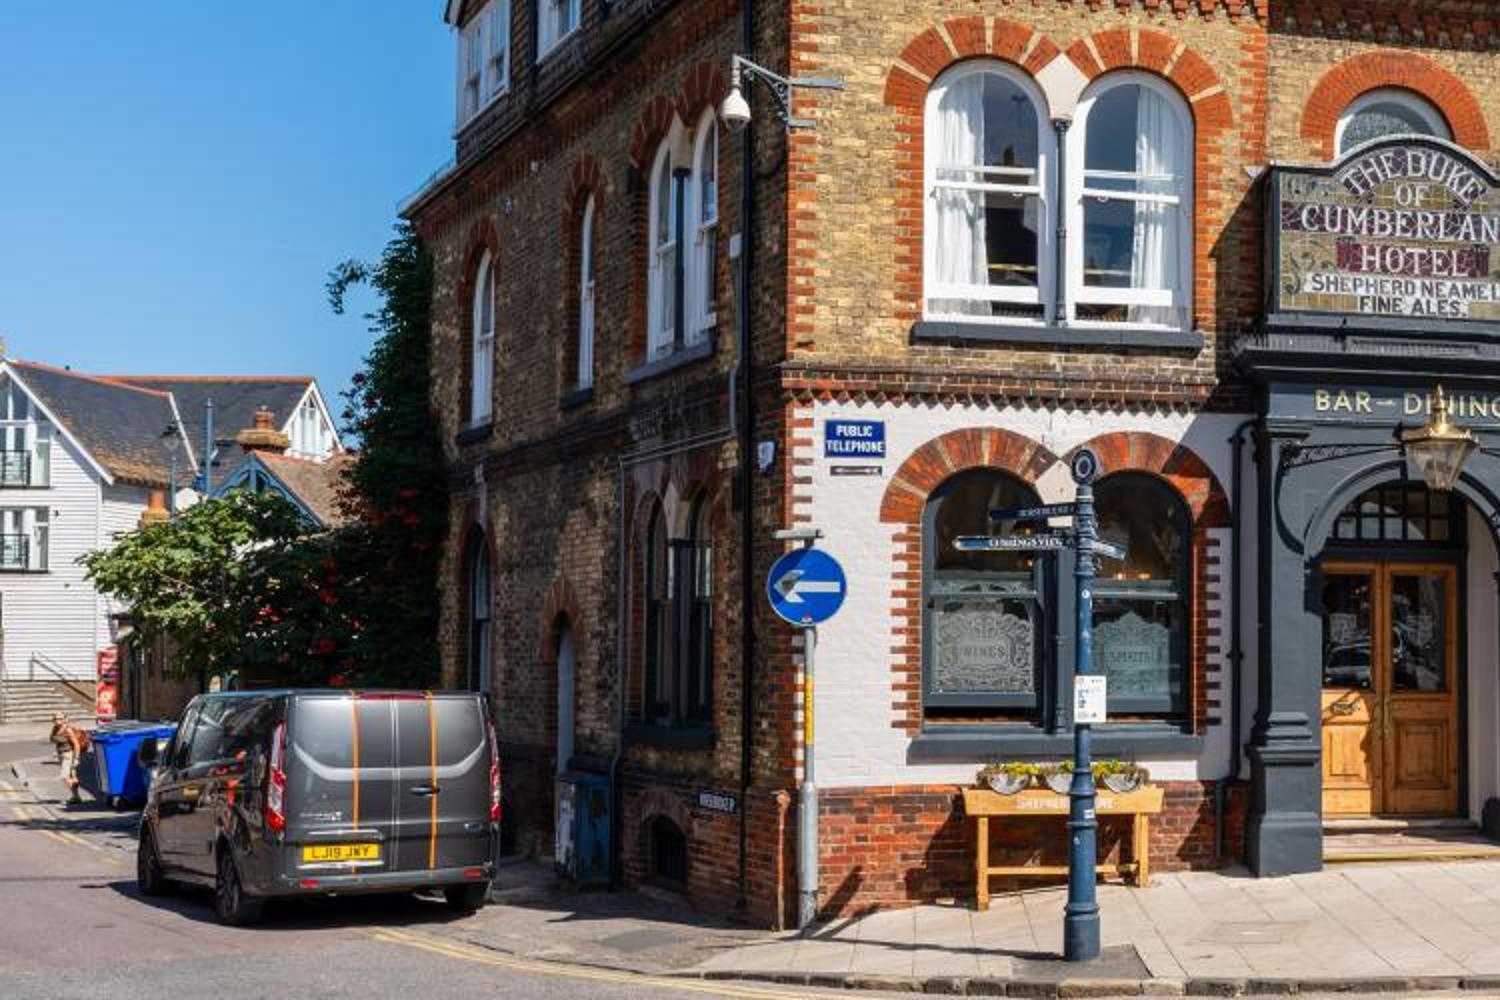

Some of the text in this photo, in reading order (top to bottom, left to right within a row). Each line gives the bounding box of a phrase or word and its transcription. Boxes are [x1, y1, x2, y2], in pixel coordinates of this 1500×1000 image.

[1344, 150, 1487, 204] THE DUKE
[1396, 186, 1428, 206] OF
[1361, 248, 1468, 278] HOTEL
[1311, 273, 1415, 296] SHEPHERD
[1421, 280, 1487, 299] NEAME
[1359, 295, 1402, 313] FINE
[1315, 390, 1373, 412] BAR
[835, 425, 873, 437] PUBLIC
[827, 440, 885, 453] TELEPHONE
[962, 646, 1006, 659] WINES
[1016, 797, 1070, 809] SHEPHER
[311, 847, 341, 859] LJ19
